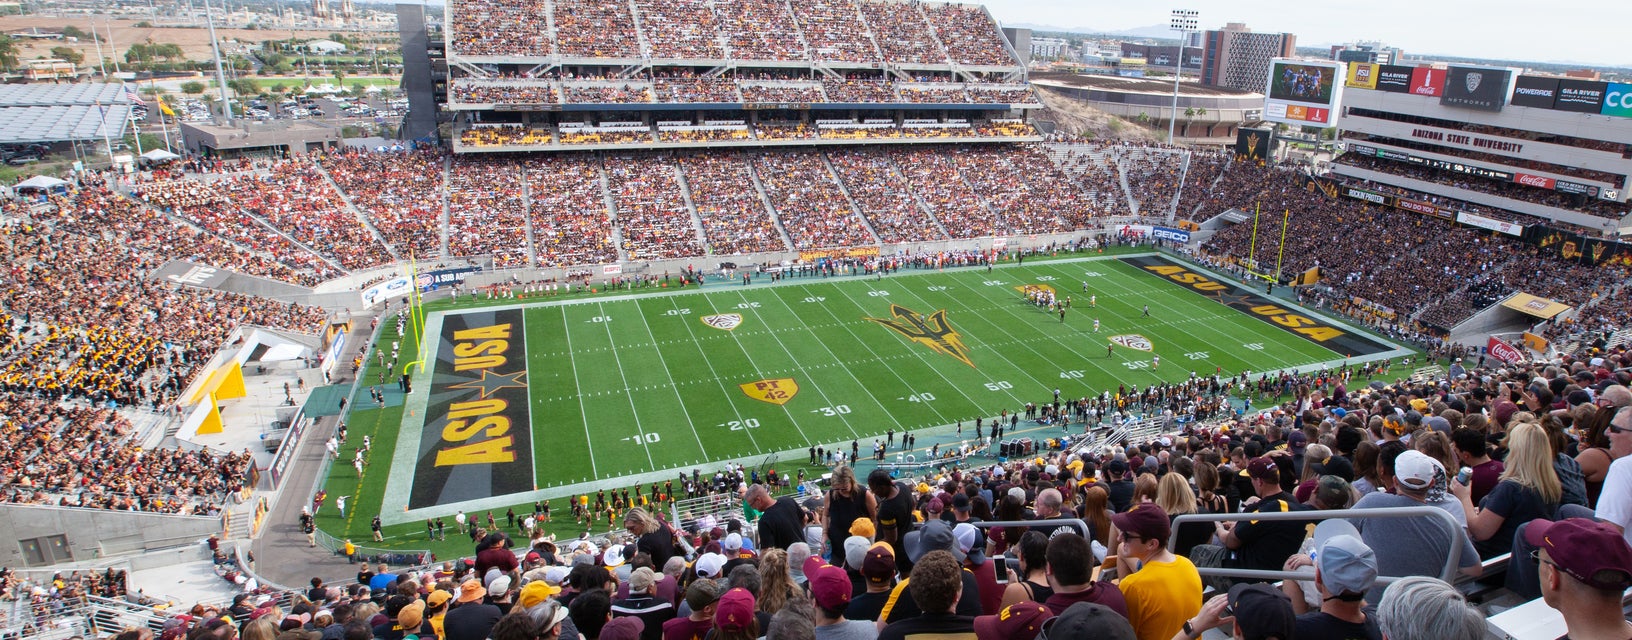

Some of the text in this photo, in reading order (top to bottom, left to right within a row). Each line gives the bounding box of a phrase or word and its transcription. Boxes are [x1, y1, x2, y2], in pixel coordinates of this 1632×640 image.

[1516, 88, 1553, 97] POWERADE
[1448, 98, 1490, 106] NETWORKS
[1412, 129, 1523, 153] ARIZONA STATE UNIVERSITY
[1520, 175, 1548, 187] Coca-Cola
[1366, 191, 1384, 204] PROTEIN
[1401, 200, 1412, 209] YOU
[1422, 206, 1434, 214] YOU
[1154, 230, 1189, 242] GEICO
[435, 274, 440, 282] A
[441, 273, 454, 282] SUB
[1144, 266, 1228, 290] ASU
[1250, 305, 1345, 342] USA
[1122, 361, 1149, 370] 30
[1060, 370, 1084, 380] 40
[755, 381, 778, 390] PT
[984, 380, 1014, 391] 50
[434, 323, 518, 468] ASU USA
[764, 391, 788, 400] 42
[908, 392, 936, 402] 40
[820, 404, 852, 417] 30
[728, 418, 760, 431] 20
[633, 432, 660, 445] 10
